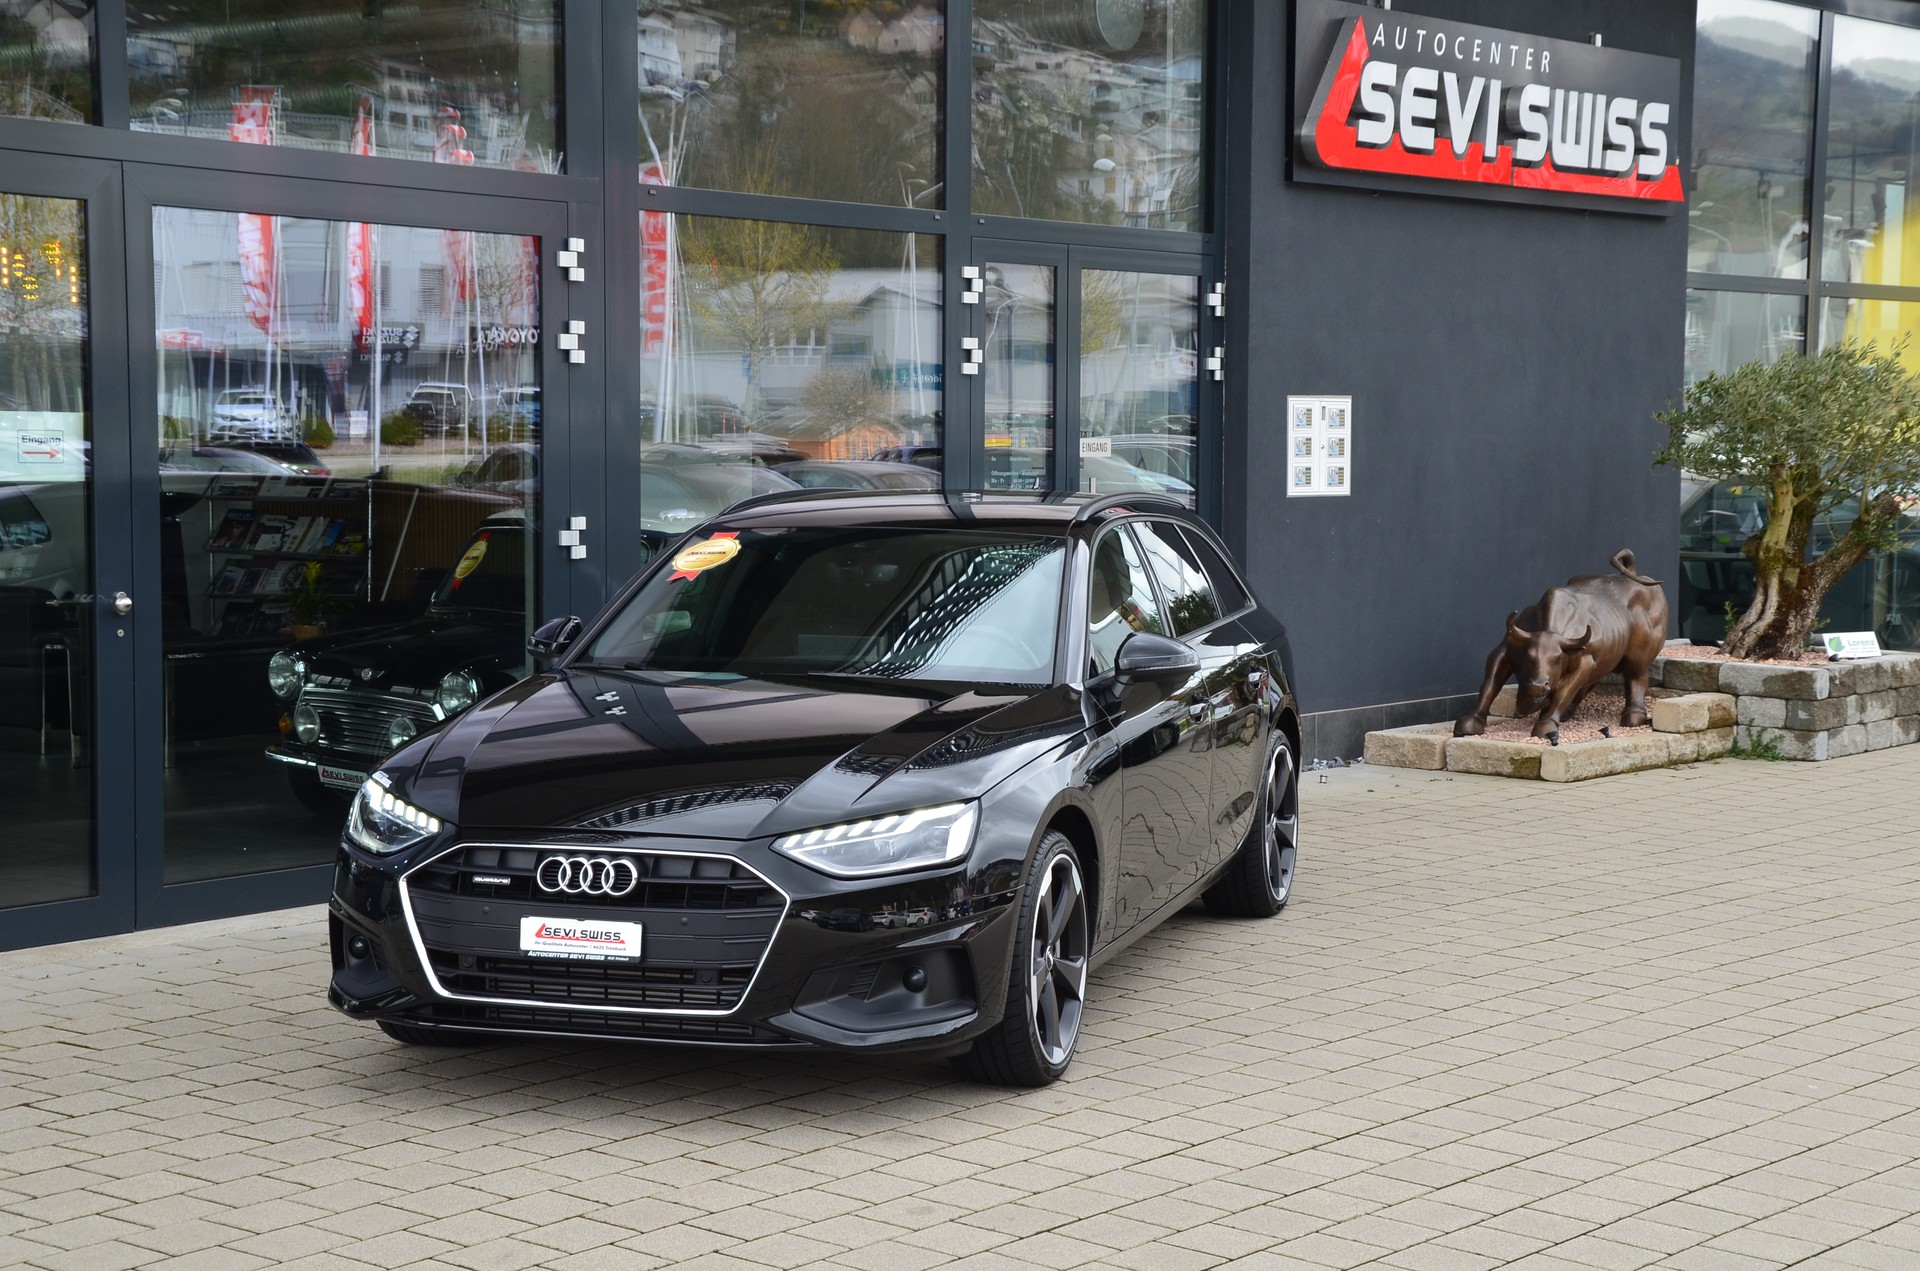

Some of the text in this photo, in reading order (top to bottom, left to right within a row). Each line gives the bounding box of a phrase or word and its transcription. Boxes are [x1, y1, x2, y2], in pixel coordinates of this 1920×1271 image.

[1372, 22, 1551, 73] AUTOCENTER
[1357, 60, 1670, 177] SEVI SWISS
[21, 435, 61, 445] Eingang
[1082, 442, 1108, 453] EINGANG
[1847, 639, 1875, 647] Lorenz
[544, 927, 621, 941] SEVI SWISS
